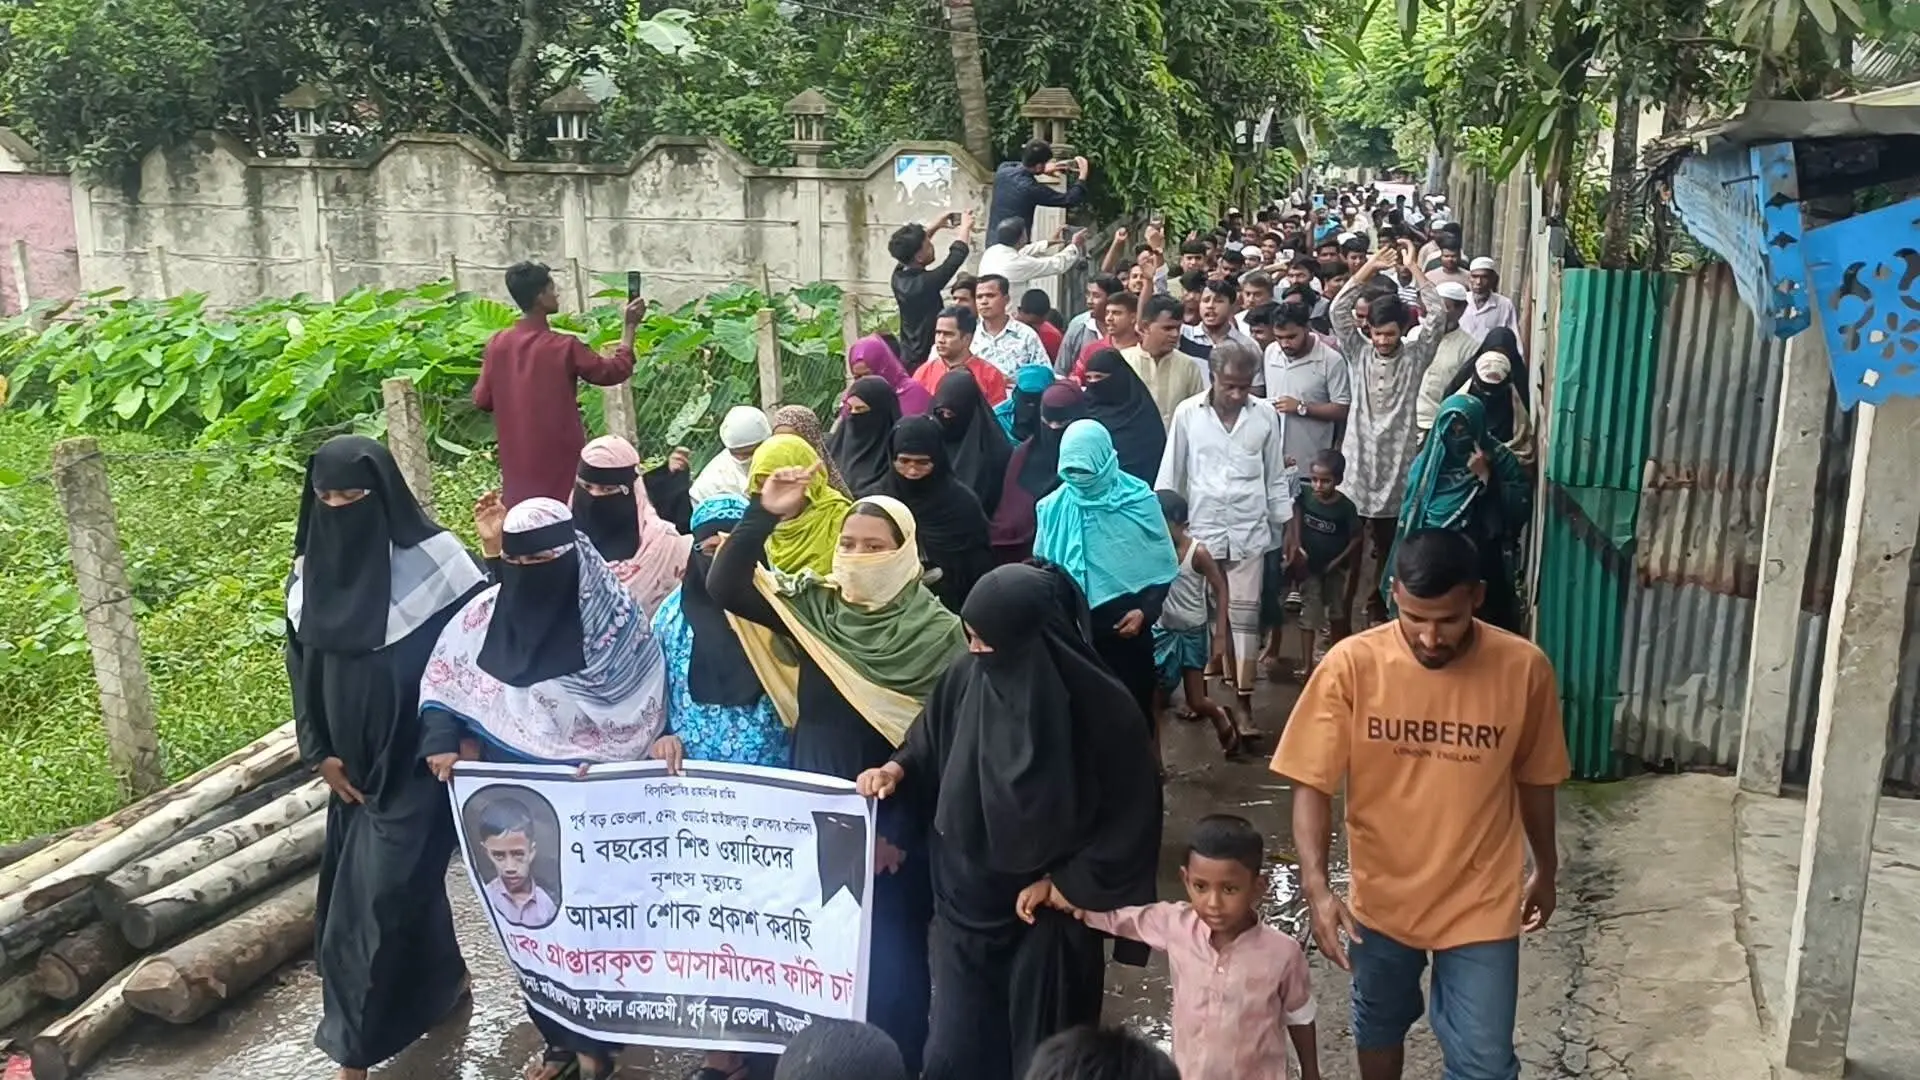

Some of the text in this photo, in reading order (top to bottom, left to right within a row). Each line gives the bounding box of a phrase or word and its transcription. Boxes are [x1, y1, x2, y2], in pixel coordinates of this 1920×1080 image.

[1367, 717, 1507, 749] BURBERRY
[1437, 751, 1481, 763] ENGLAND
[570, 810, 586, 831] পূর্ব
[589, 812, 608, 829] বড়
[571, 828, 794, 869] ৭ বছরের শিশু ওয়াহিদের
[650, 872, 742, 893] নৃশংস মৃত্যুতে
[565, 901, 813, 950] আমরা শোক প্রকাশ করছি
[664, 943, 776, 985] আসামীদের
[780, 955, 824, 998] ফাঁসি
[583, 991, 623, 1021] ফুটবল
[687, 998, 708, 1031] পূর্ব
[709, 1004, 730, 1031] বড়
